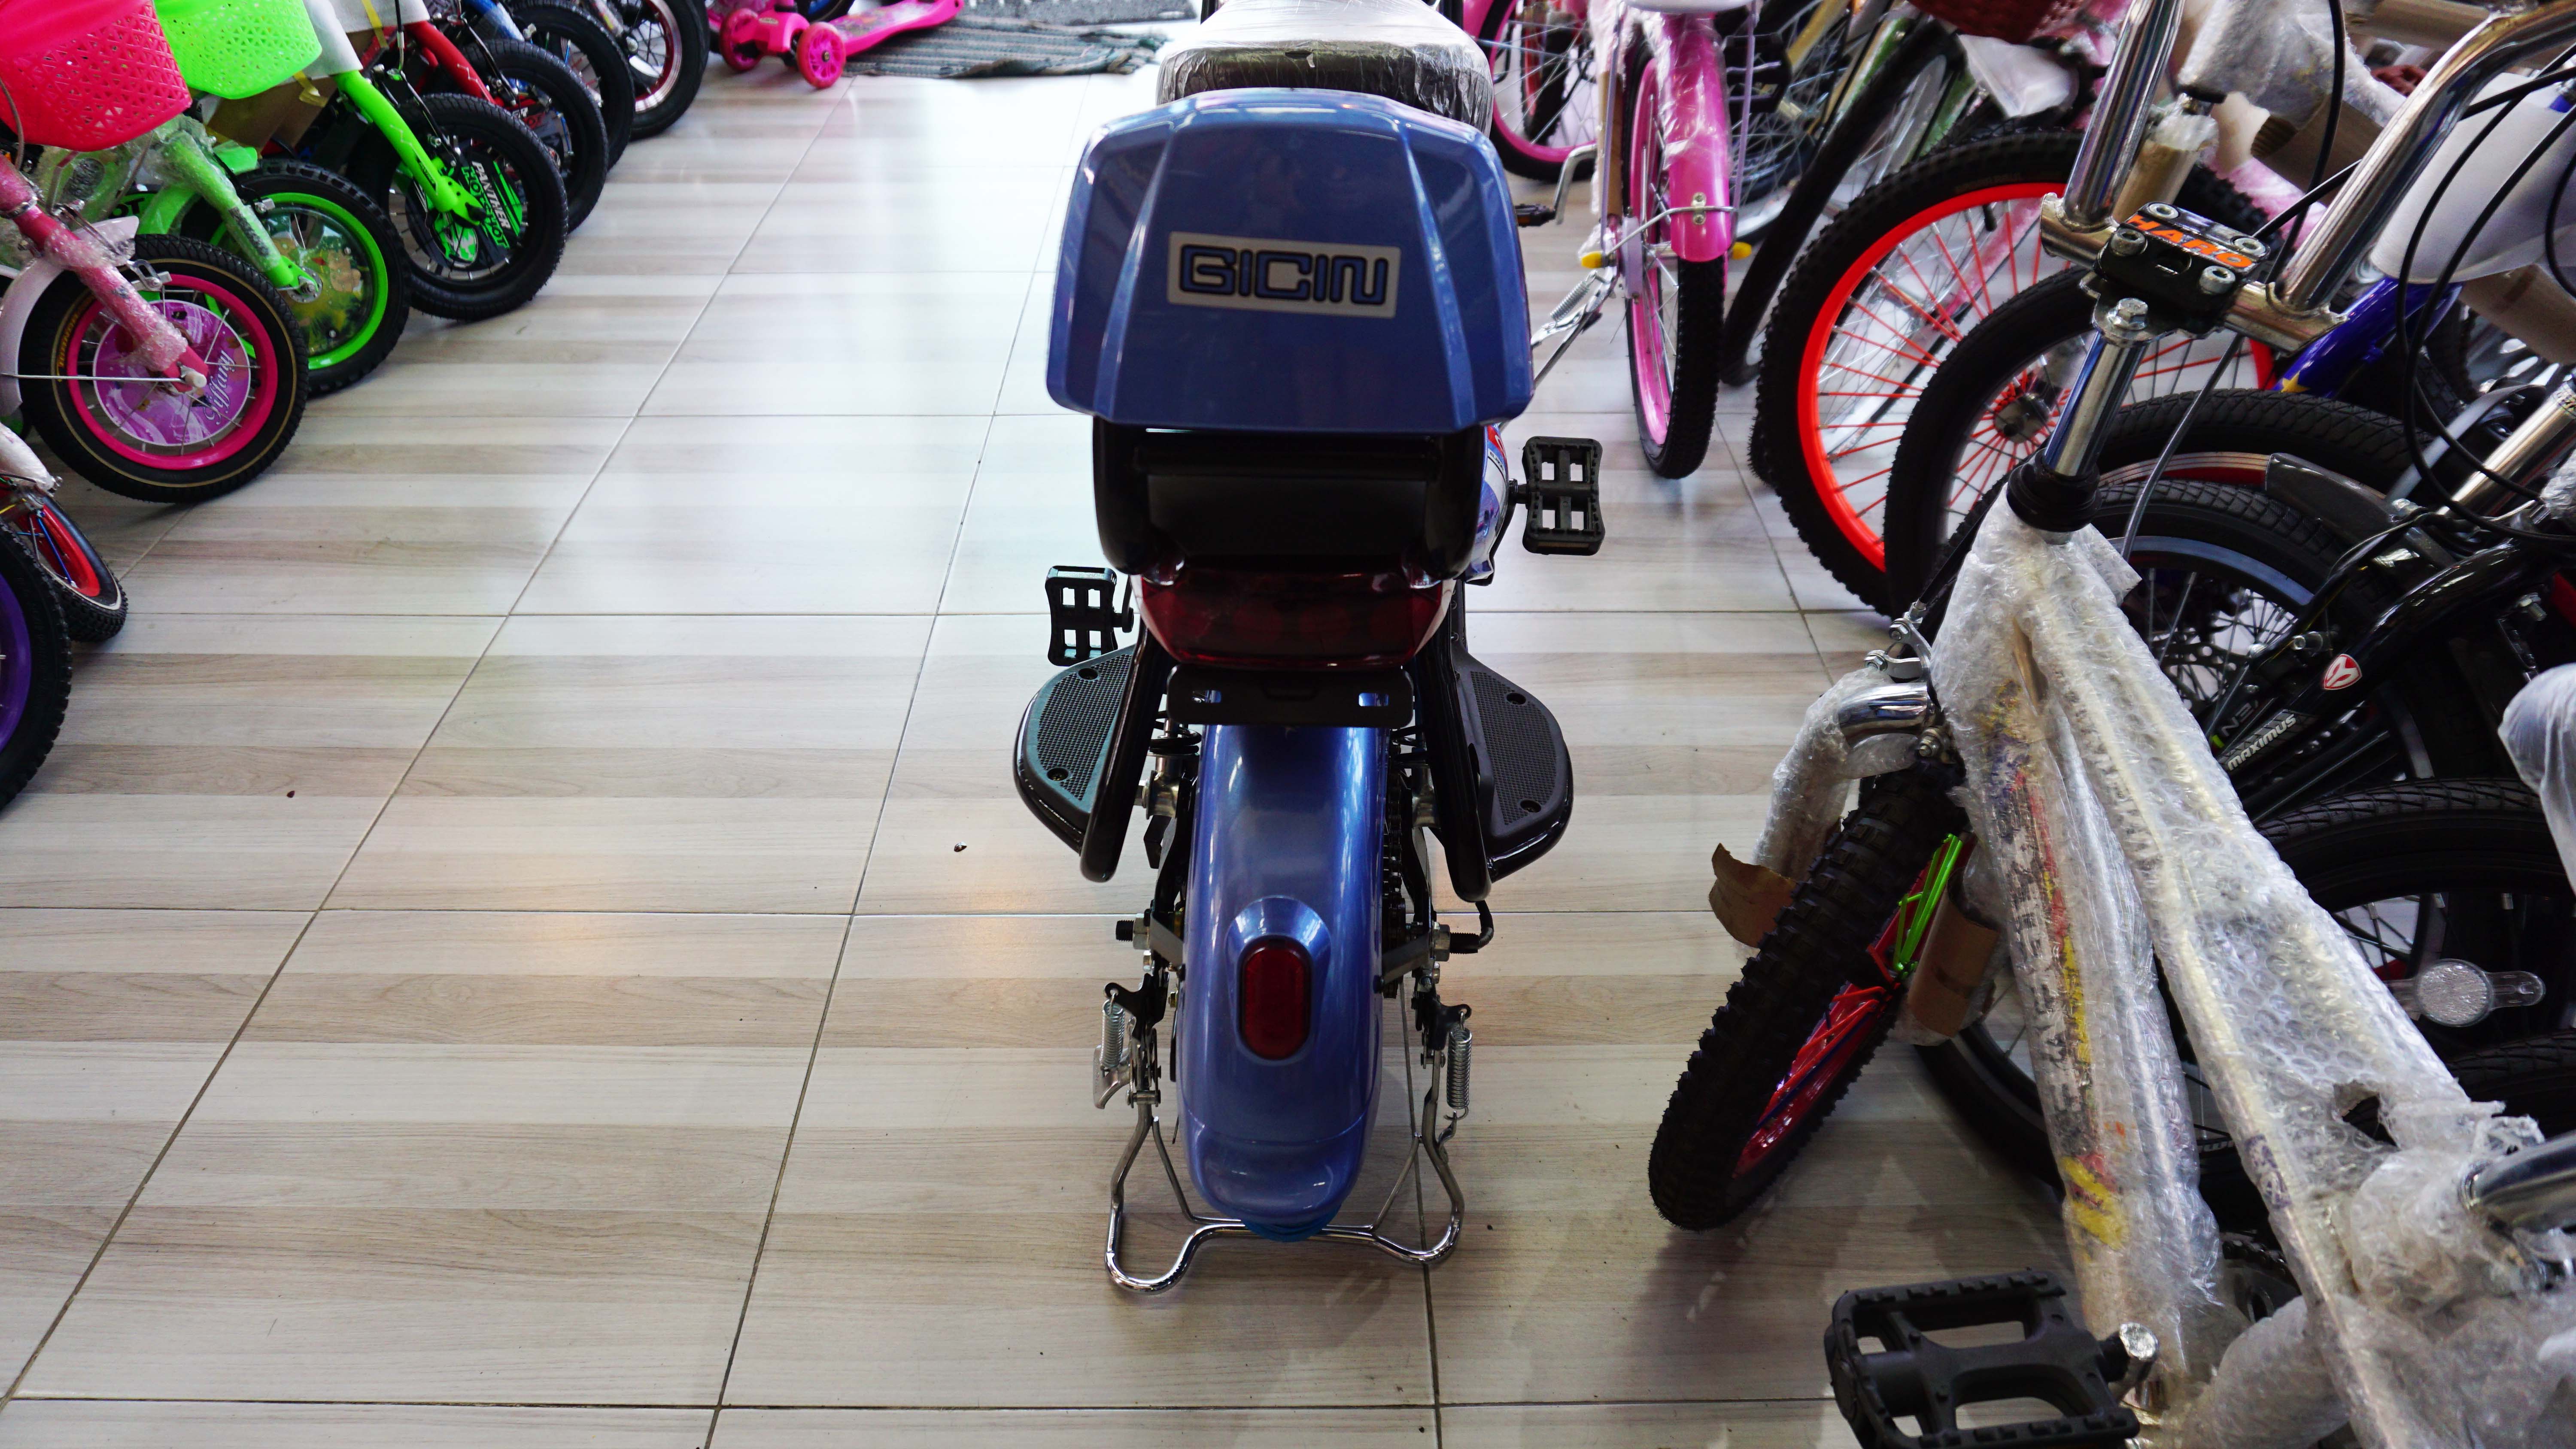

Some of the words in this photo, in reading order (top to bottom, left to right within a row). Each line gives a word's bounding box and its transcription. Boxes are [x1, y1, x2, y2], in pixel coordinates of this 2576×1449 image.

[472, 161, 512, 229] PANTHER
[2127, 214, 2253, 268] HARO
[1179, 244, 1388, 306] GICIN
[203, 350, 235, 425] Tiffany
